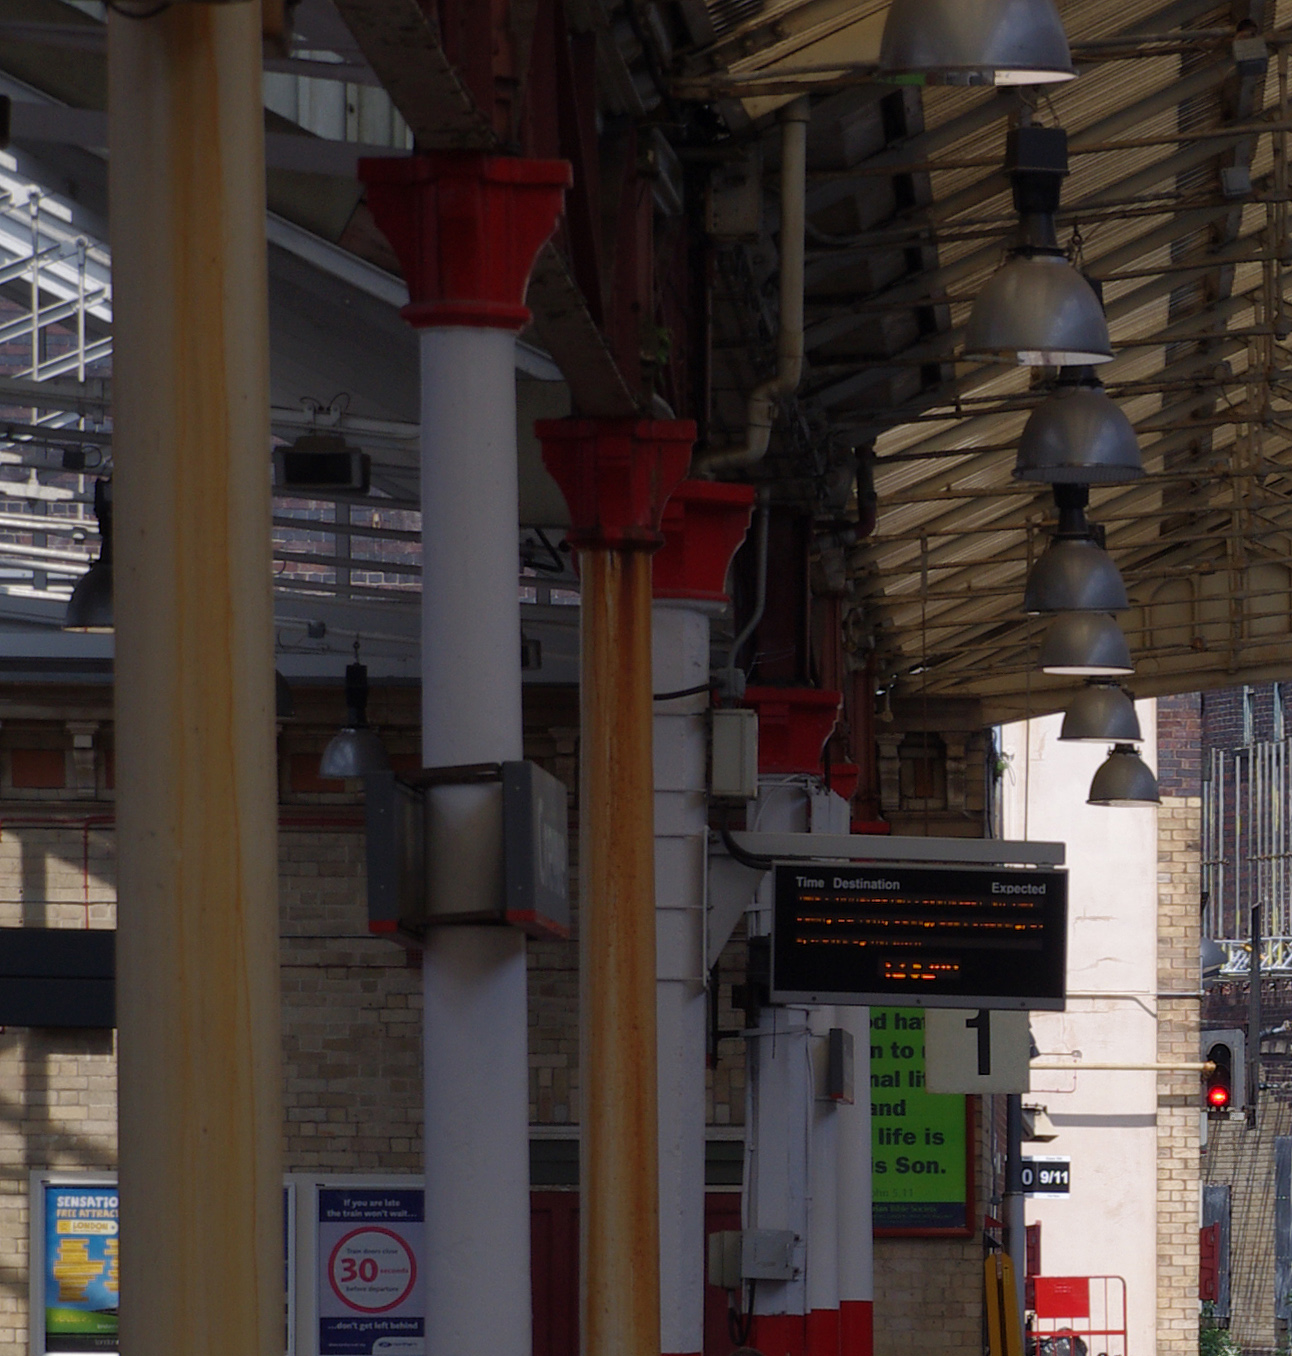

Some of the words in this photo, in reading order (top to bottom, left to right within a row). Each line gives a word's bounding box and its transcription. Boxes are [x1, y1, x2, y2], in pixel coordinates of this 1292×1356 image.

[796, 876, 825, 888] Time
[833, 877, 901, 890] Destination
[992, 882, 1047, 896] Expected
[965, 1009, 991, 1076] 1
[891, 1042, 914, 1059] to
[878, 1127, 917, 1145] life
[924, 1128, 945, 1145] is
[896, 1156, 946, 1174] Son.
[1040, 1170, 1069, 1184] 9/11
[343, 1199, 351, 1207] If
[352, 1200, 368, 1209] you
[385, 1199, 401, 1207] late
[56, 1208, 77, 1218] FREE
[327, 1210, 341, 1218] the
[343, 1210, 363, 1218] train
[364, 1210, 388, 1218] won't
[73, 1222, 109, 1231] LONDON
[341, 1257, 378, 1283] 30
[368, 1286, 399, 1294] departure
[359, 1323, 373, 1332] get
[374, 1321, 389, 1330] left
[390, 1321, 418, 1330] behind
